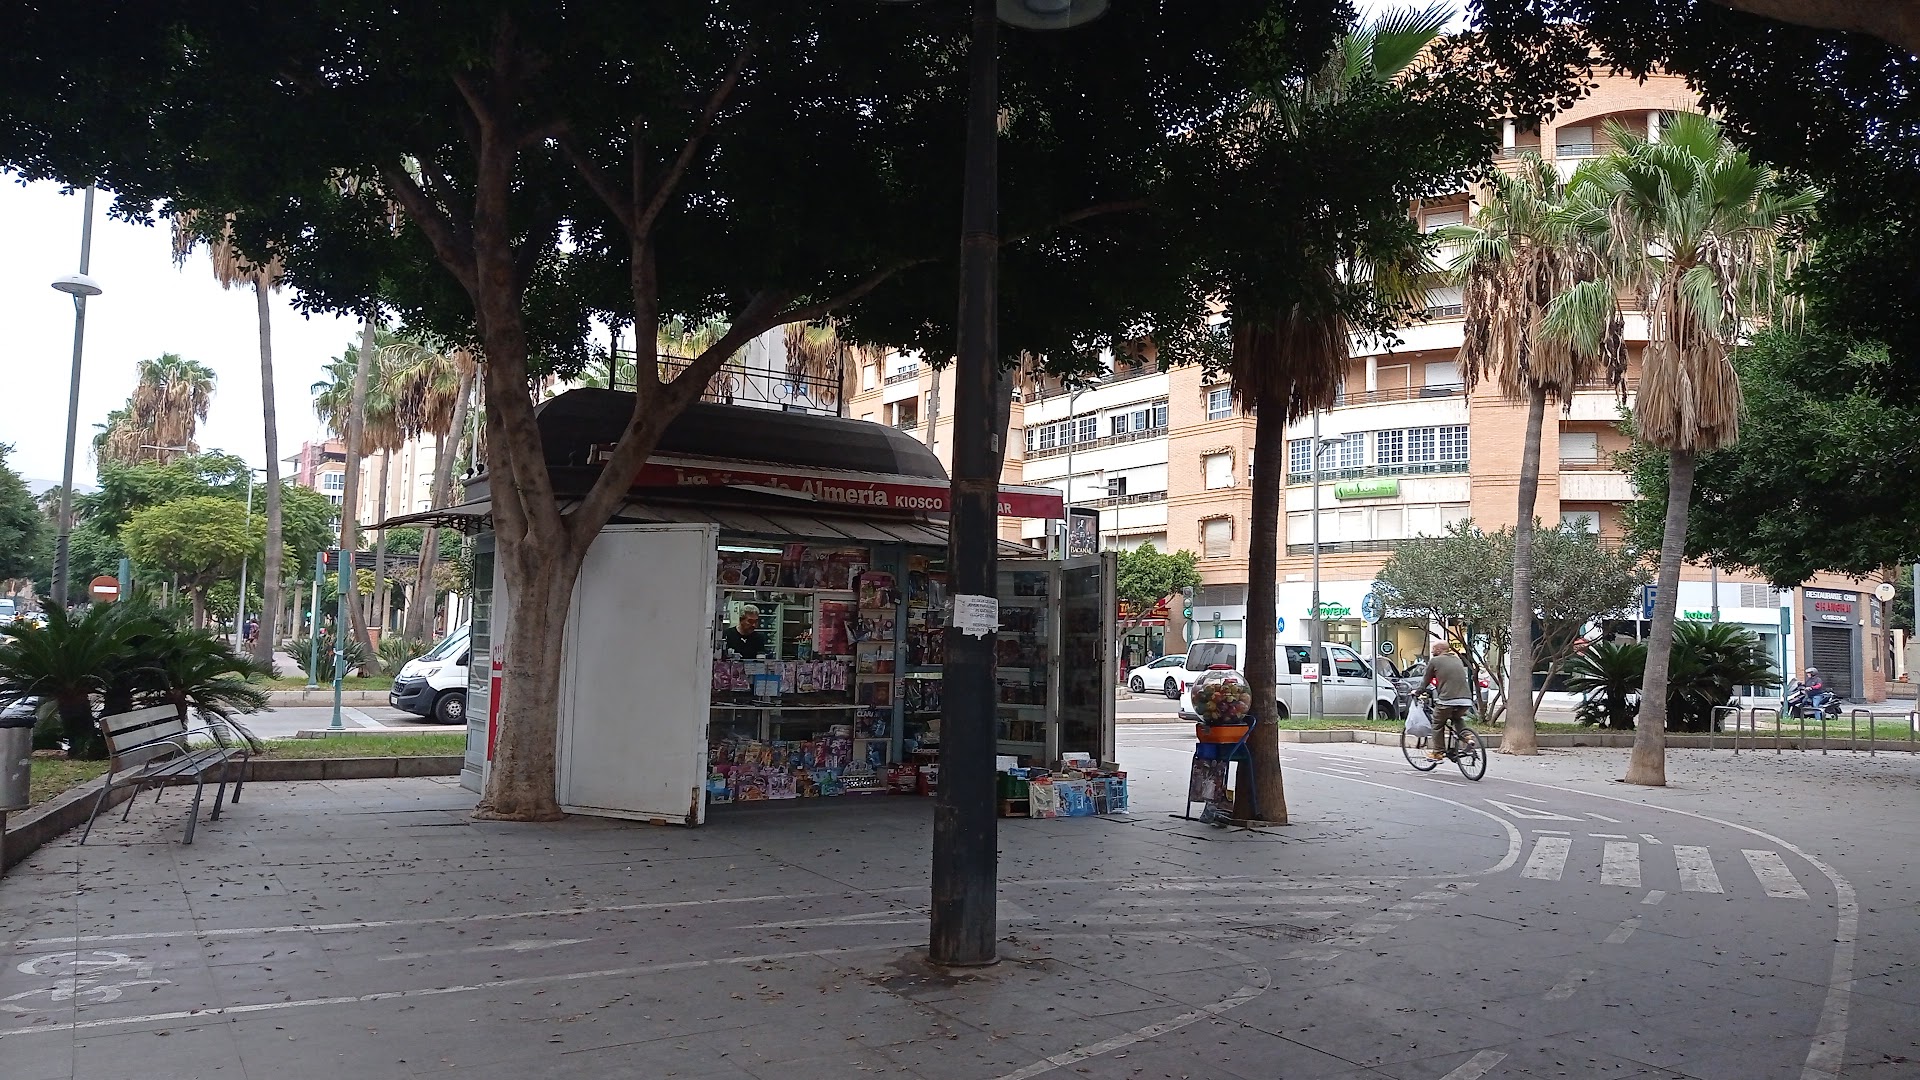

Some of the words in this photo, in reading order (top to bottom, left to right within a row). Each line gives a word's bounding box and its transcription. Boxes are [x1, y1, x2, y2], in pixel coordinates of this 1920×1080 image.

[801, 479, 889, 507] Almería
[895, 495, 943, 510] KIOSCO
[996, 502, 1013, 514] AR
[1805, 590, 1843, 601] RESTAURANTE
[1307, 607, 1351, 616] VRWERK
[1815, 601, 1852, 613] SHANGHAI
[1683, 609, 1720, 619] kobo
